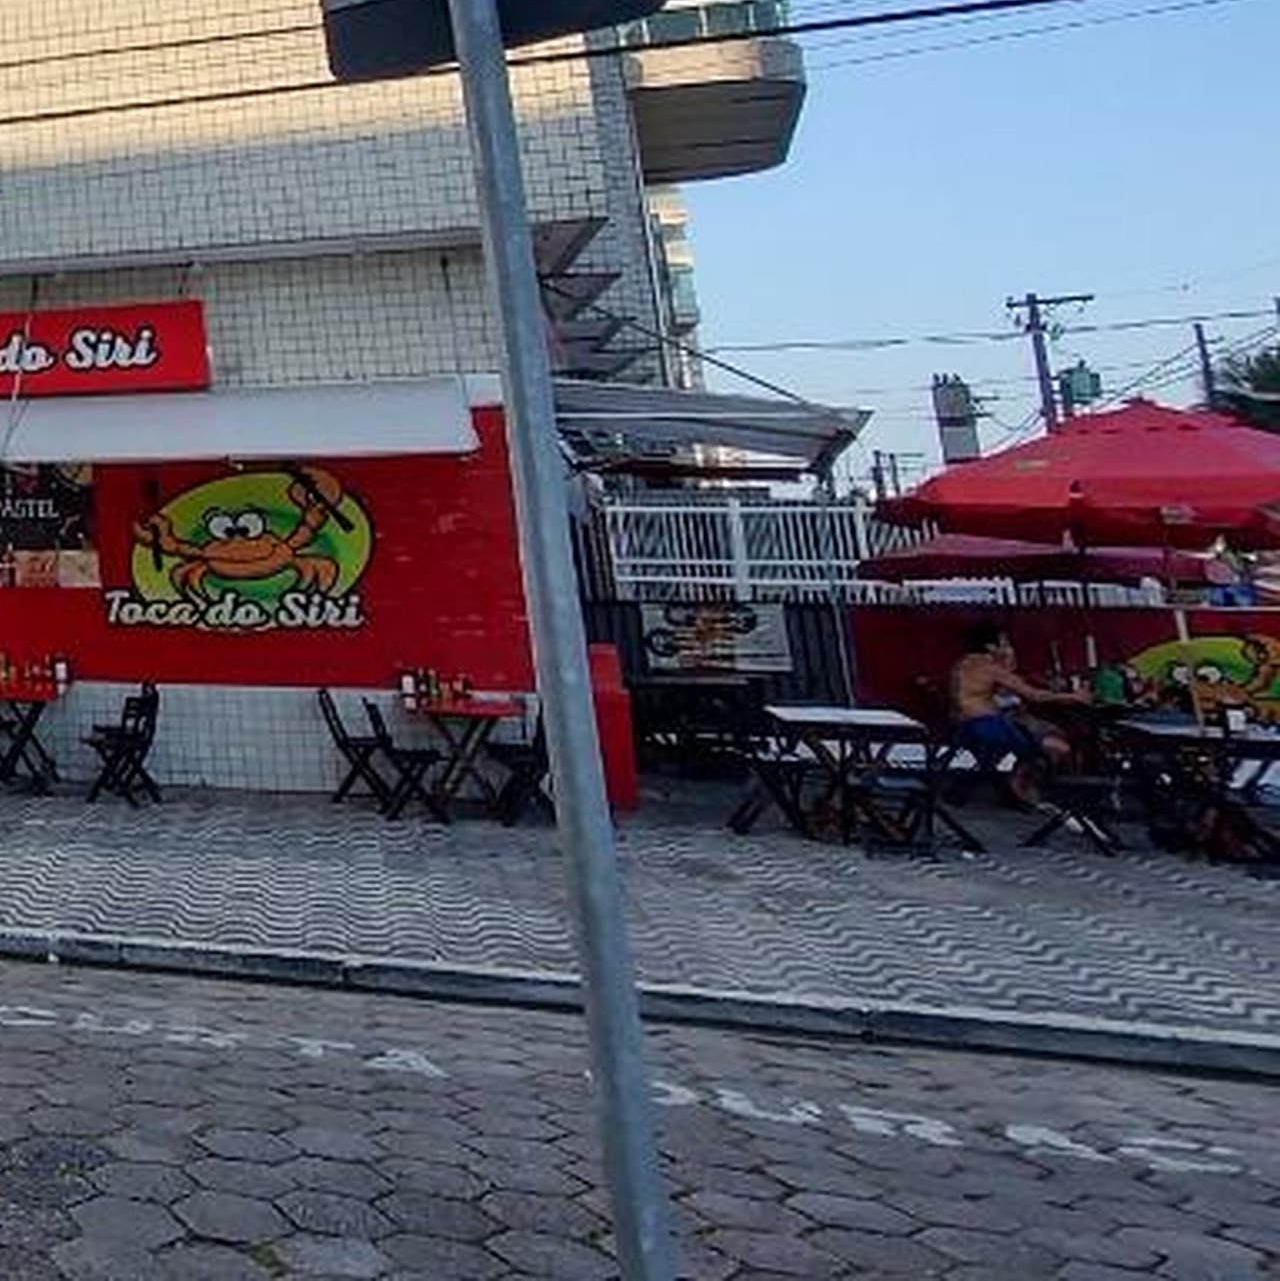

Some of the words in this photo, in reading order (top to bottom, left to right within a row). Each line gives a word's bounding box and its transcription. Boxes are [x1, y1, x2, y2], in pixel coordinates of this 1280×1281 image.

[64, 329, 157, 369] Siri
[104, 589, 200, 625] Toca
[203, 591, 269, 626] do
[277, 591, 364, 627] Siri
